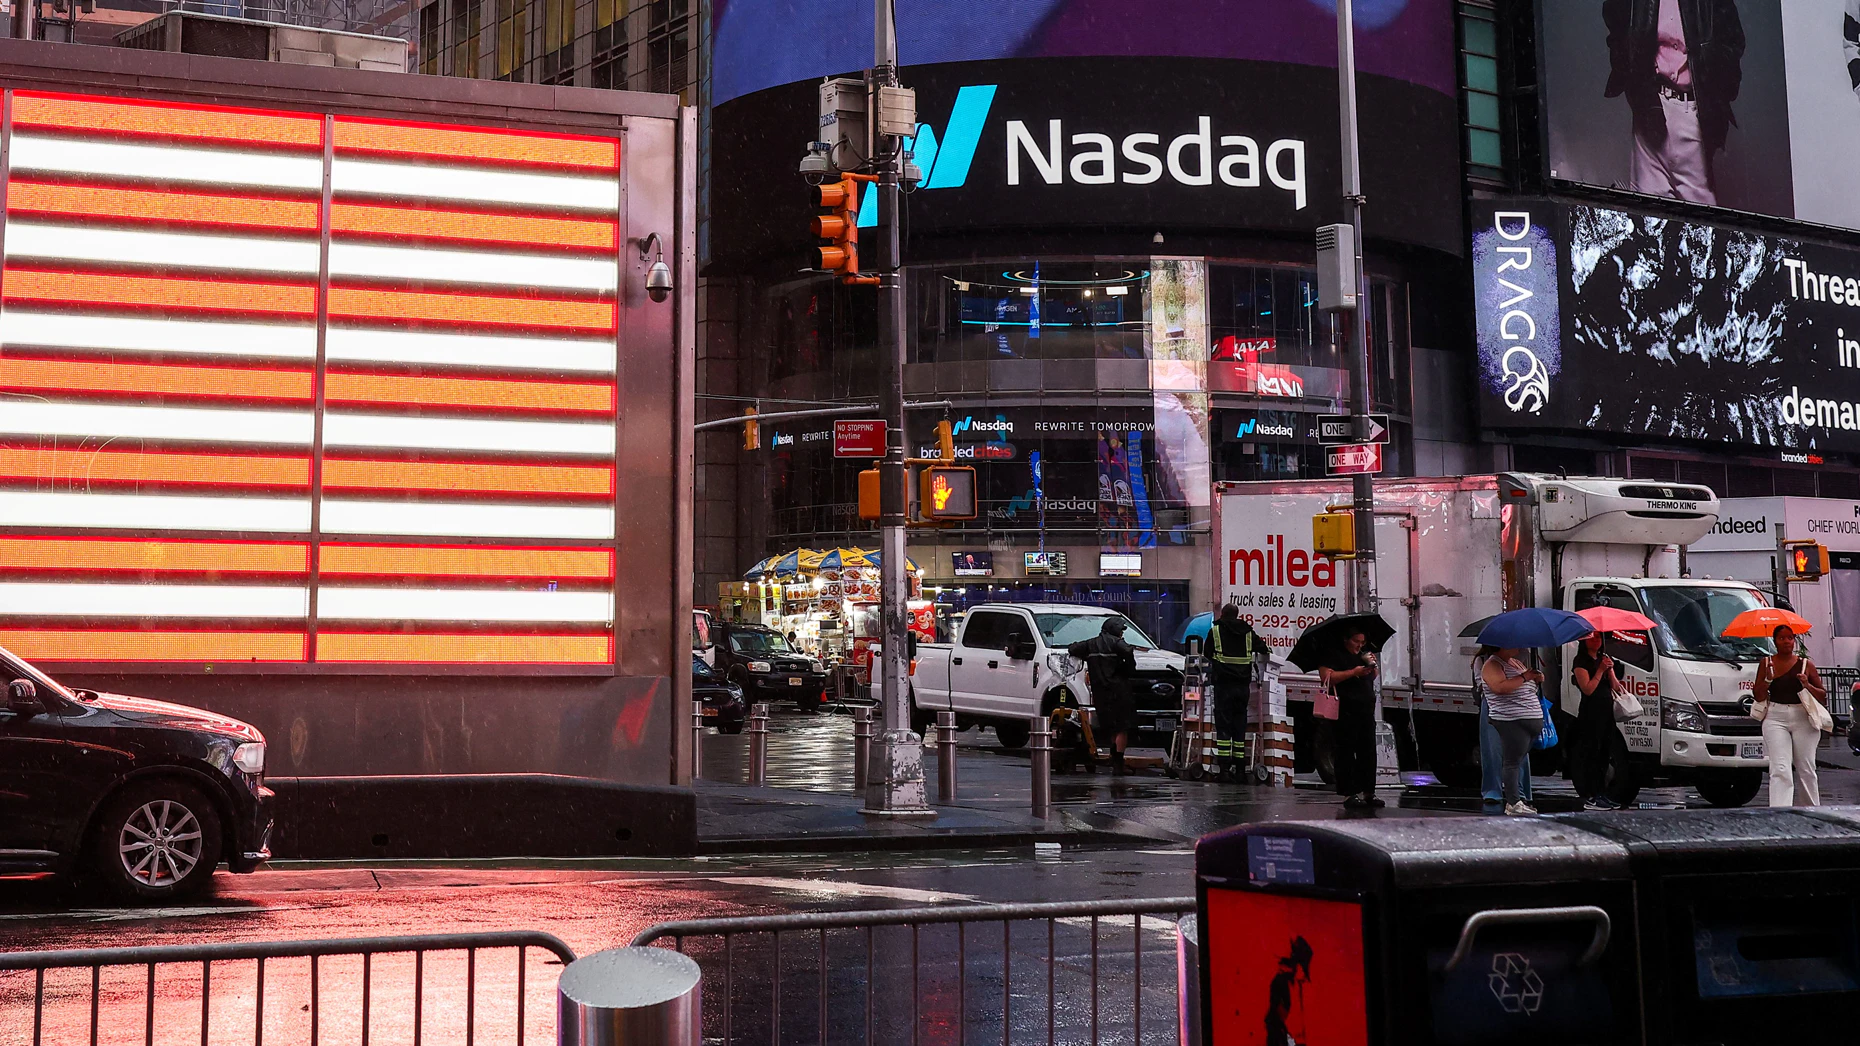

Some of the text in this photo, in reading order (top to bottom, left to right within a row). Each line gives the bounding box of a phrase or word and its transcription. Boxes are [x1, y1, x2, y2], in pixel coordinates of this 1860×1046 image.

[1006, 115, 1307, 211] Nasdaq
[1783, 258, 1860, 307] Threa
[1494, 211, 1550, 416] DRAGOS
[837, 424, 874, 432] NO STOPPING
[972, 420, 1014, 433] Nasdaq
[1034, 422, 1155, 431] REWRITE TOMORROW
[1256, 423, 1293, 438] Nasdaq
[1325, 424, 1345, 435] ONE
[777, 433, 794, 446] Nasdaq
[802, 431, 829, 442] REWRITE
[837, 432, 861, 441] Anytime
[1331, 453, 1369, 466] ONE WAY
[1647, 501, 1697, 510] THERMO KING
[1708, 516, 1766, 534] ndeed
[1808, 519, 1833, 533] CHIEF
[1229, 534, 1336, 587] milea
[1229, 592, 1336, 612] truck sales & leasing
